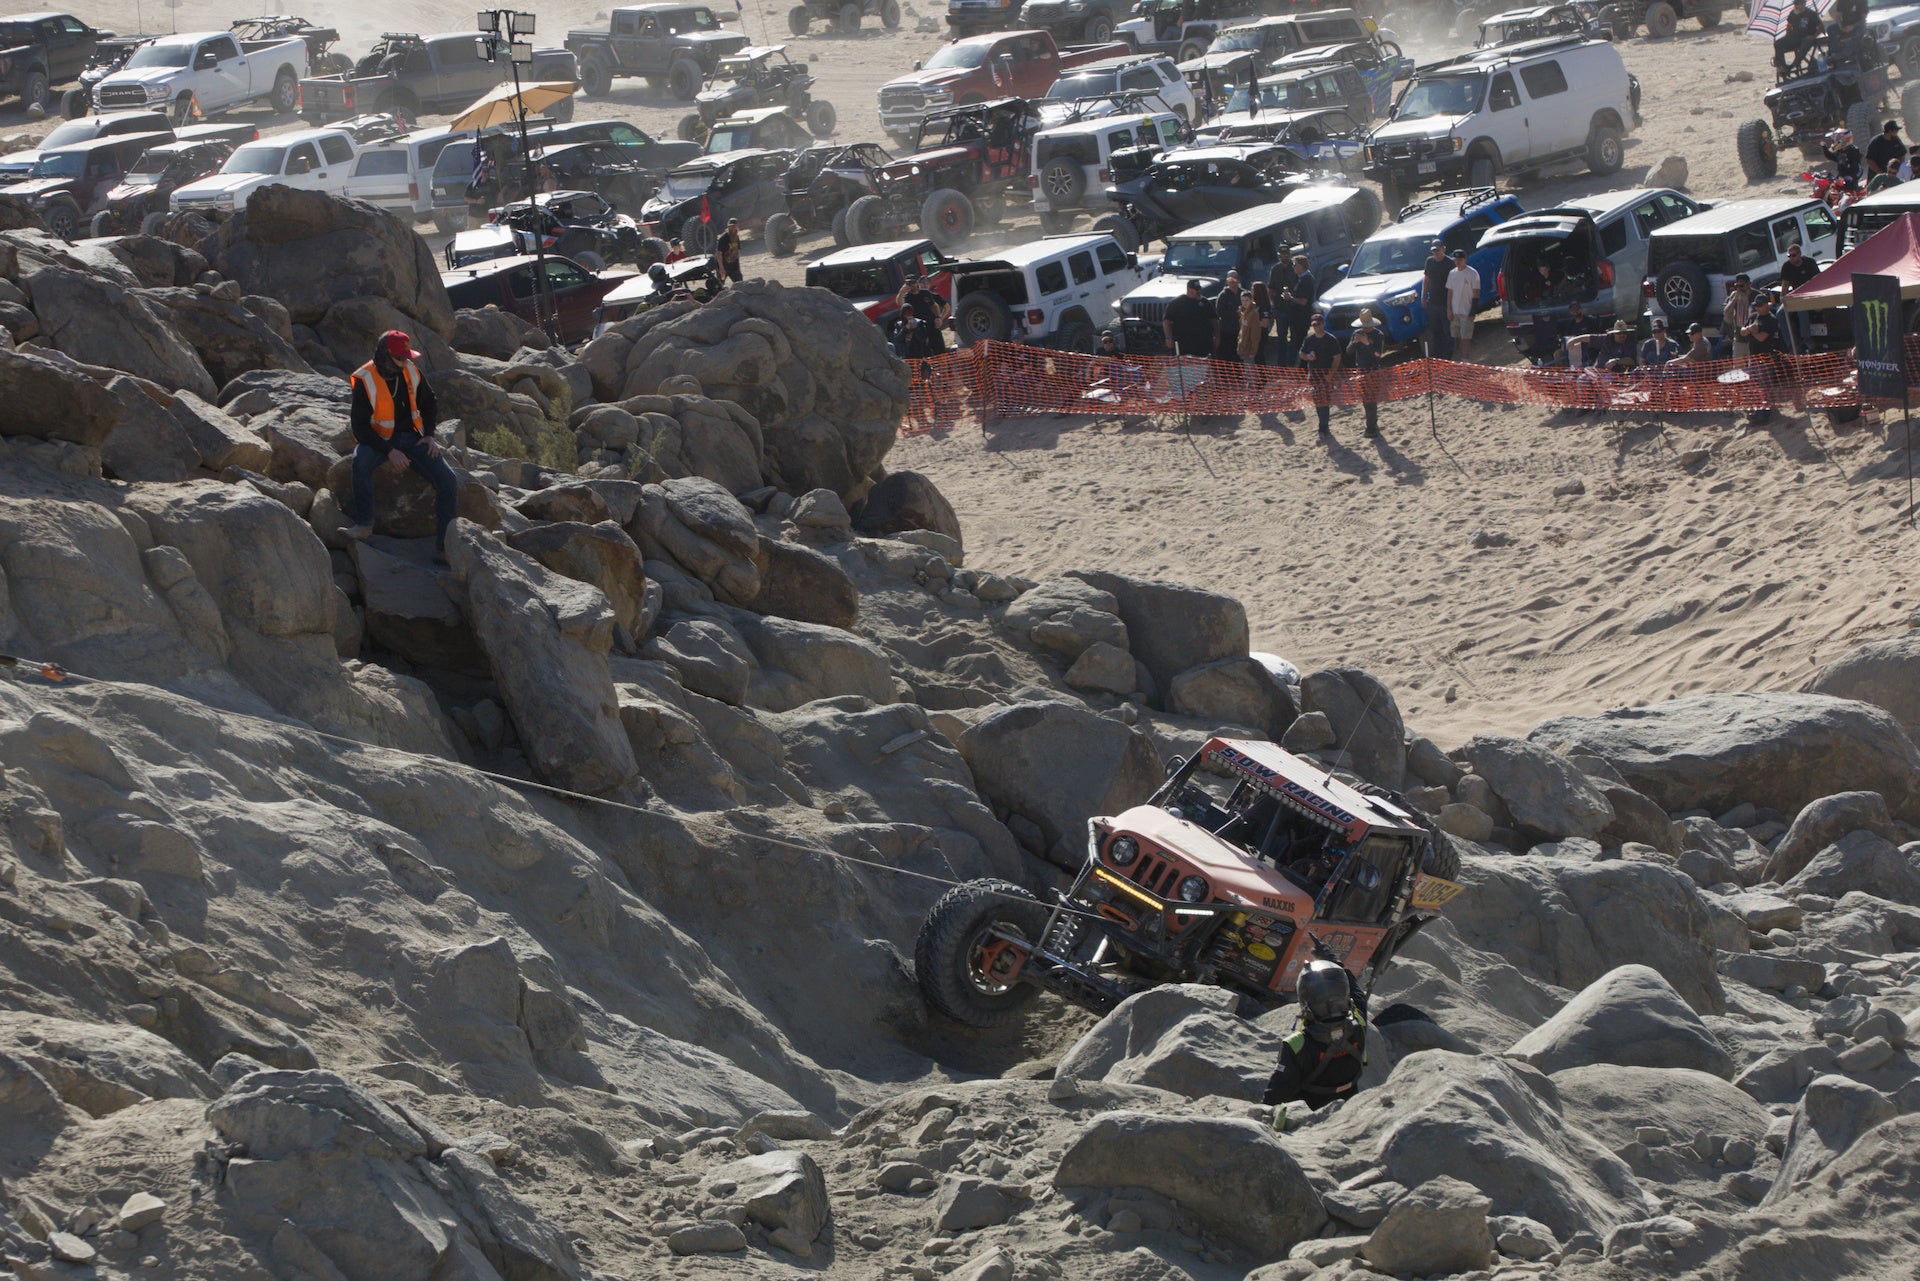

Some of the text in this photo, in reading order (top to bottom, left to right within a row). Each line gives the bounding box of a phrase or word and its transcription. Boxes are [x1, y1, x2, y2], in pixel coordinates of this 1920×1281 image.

[1858, 360, 1900, 372] MONSTER
[1281, 780, 1358, 824] RACING
[1263, 897, 1296, 913] MAXXIS
